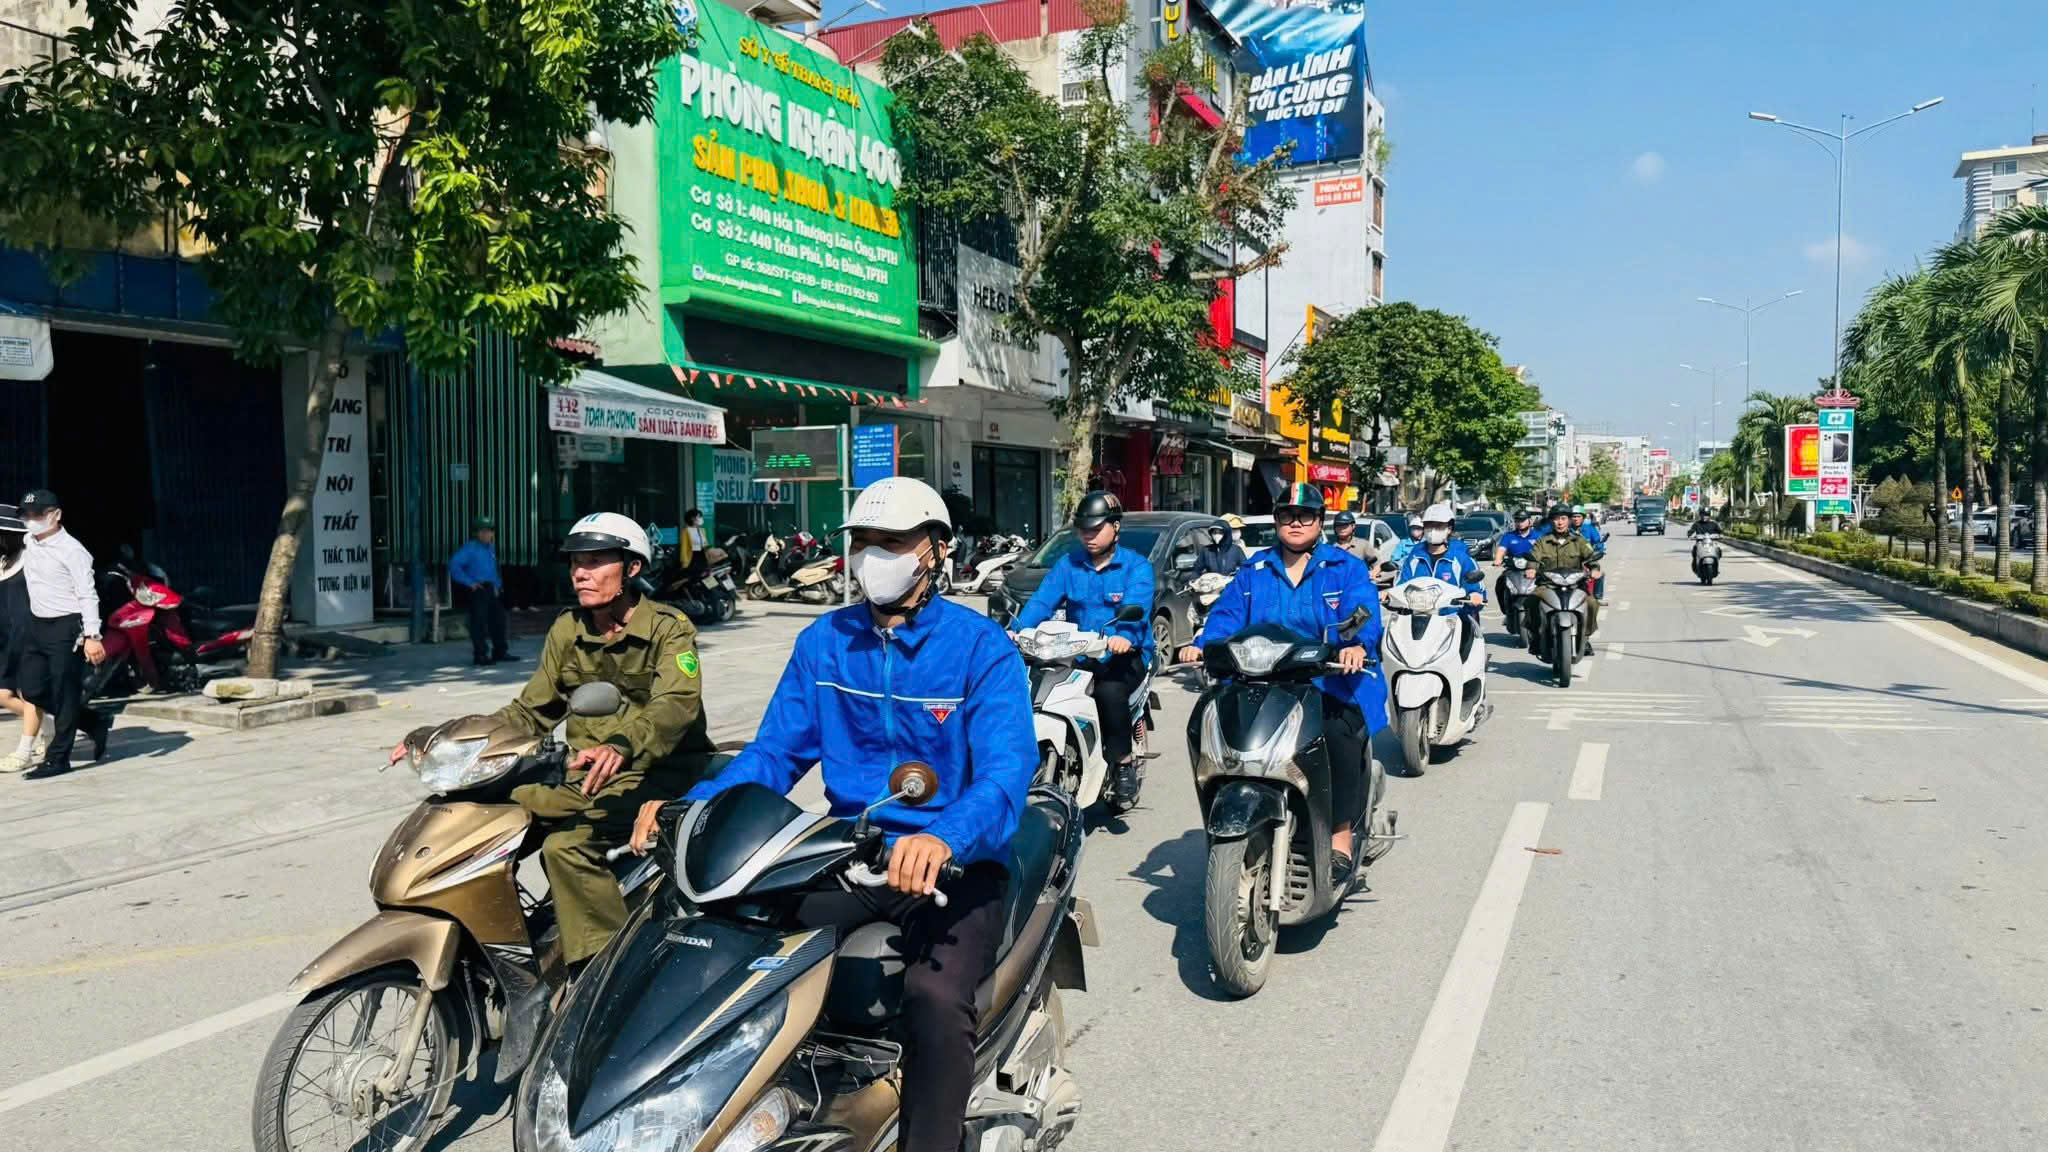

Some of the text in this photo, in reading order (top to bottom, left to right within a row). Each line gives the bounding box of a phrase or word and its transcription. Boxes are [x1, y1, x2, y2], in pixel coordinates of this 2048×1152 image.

[1165, 0, 1180, 40] UL
[680, 53, 782, 143] PHÒNG
[694, 129, 736, 182] SẢN
[741, 152, 780, 204] PHỤ
[715, 192, 734, 213] Sở
[716, 218, 734, 240] Sở
[327, 434, 352, 453] TRÍ
[326, 475, 354, 495] NỘI
[323, 509, 359, 531] THẤT
